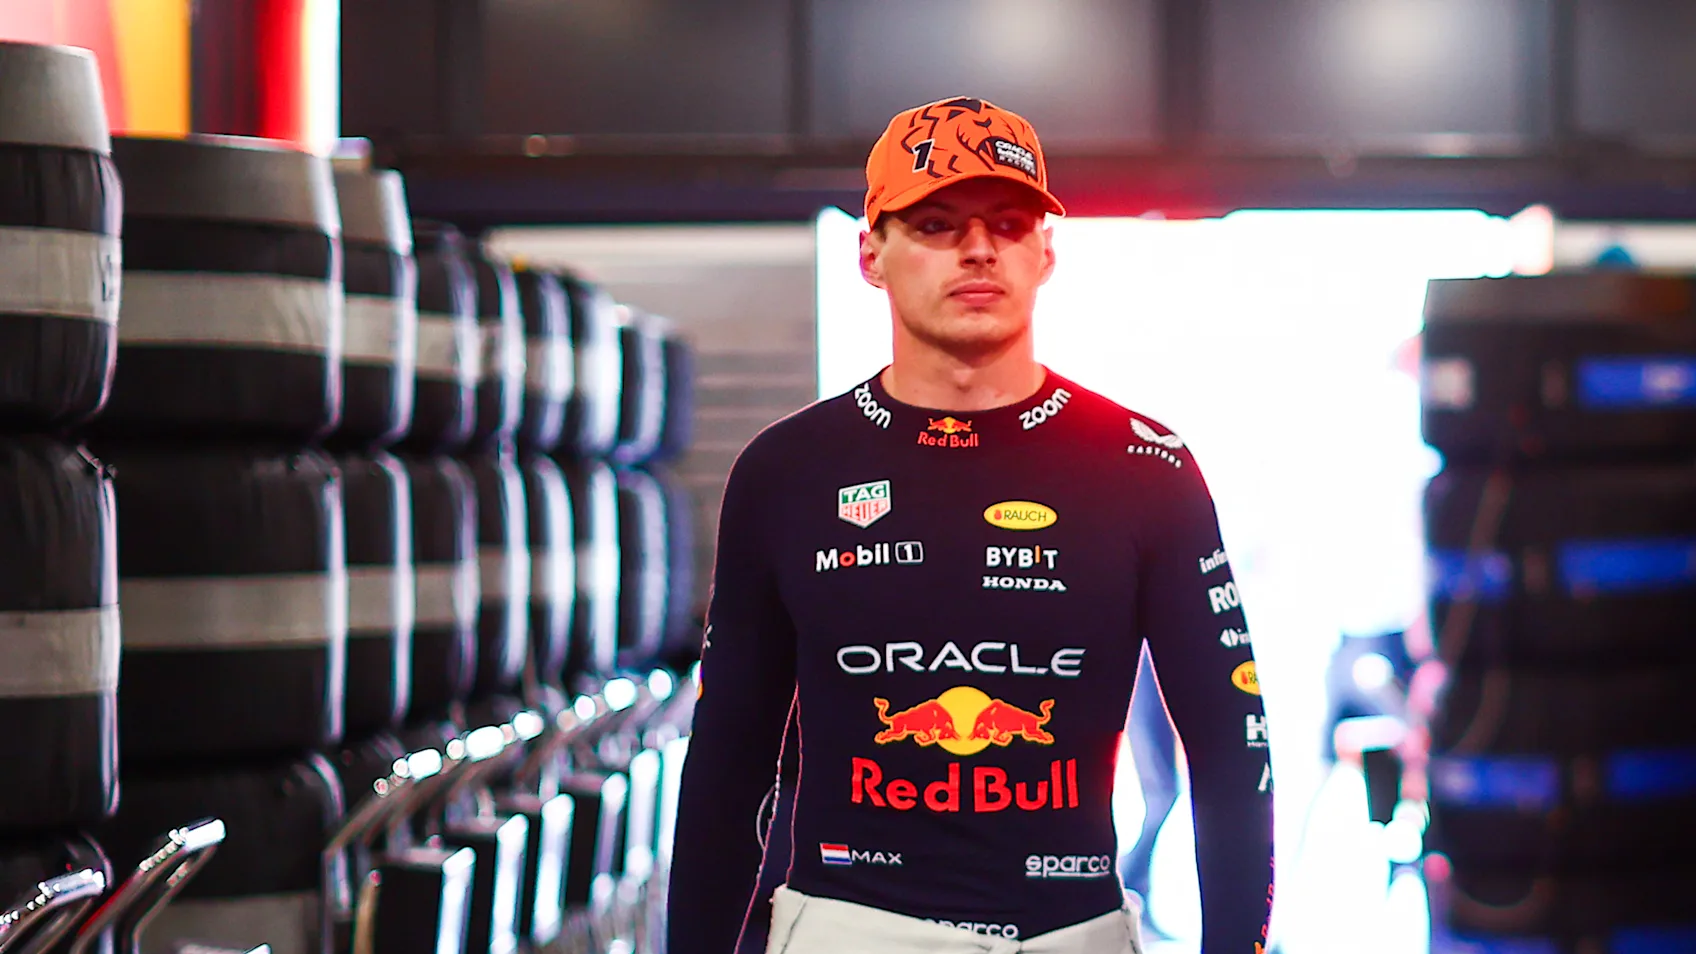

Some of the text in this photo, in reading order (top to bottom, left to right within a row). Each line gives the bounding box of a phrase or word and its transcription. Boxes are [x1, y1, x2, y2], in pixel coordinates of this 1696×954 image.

[911, 138, 935, 173] 1
[854, 383, 891, 429] zoom
[1019, 388, 1072, 430] zoom
[917, 431, 979, 448] Red Bull
[843, 484, 886, 502] TAG
[842, 501, 890, 523] HEUER
[1003, 509, 1047, 522] RAUCH
[815, 543, 890, 572] Mobil
[986, 545, 1059, 569] BYBIT
[983, 576, 1066, 591] HONDA
[1208, 581, 1240, 613] RO
[836, 641, 1086, 677] ORACLE
[851, 756, 1079, 812] Red Bull
[851, 849, 903, 865] MAX
[1025, 854, 1111, 877] sparco
